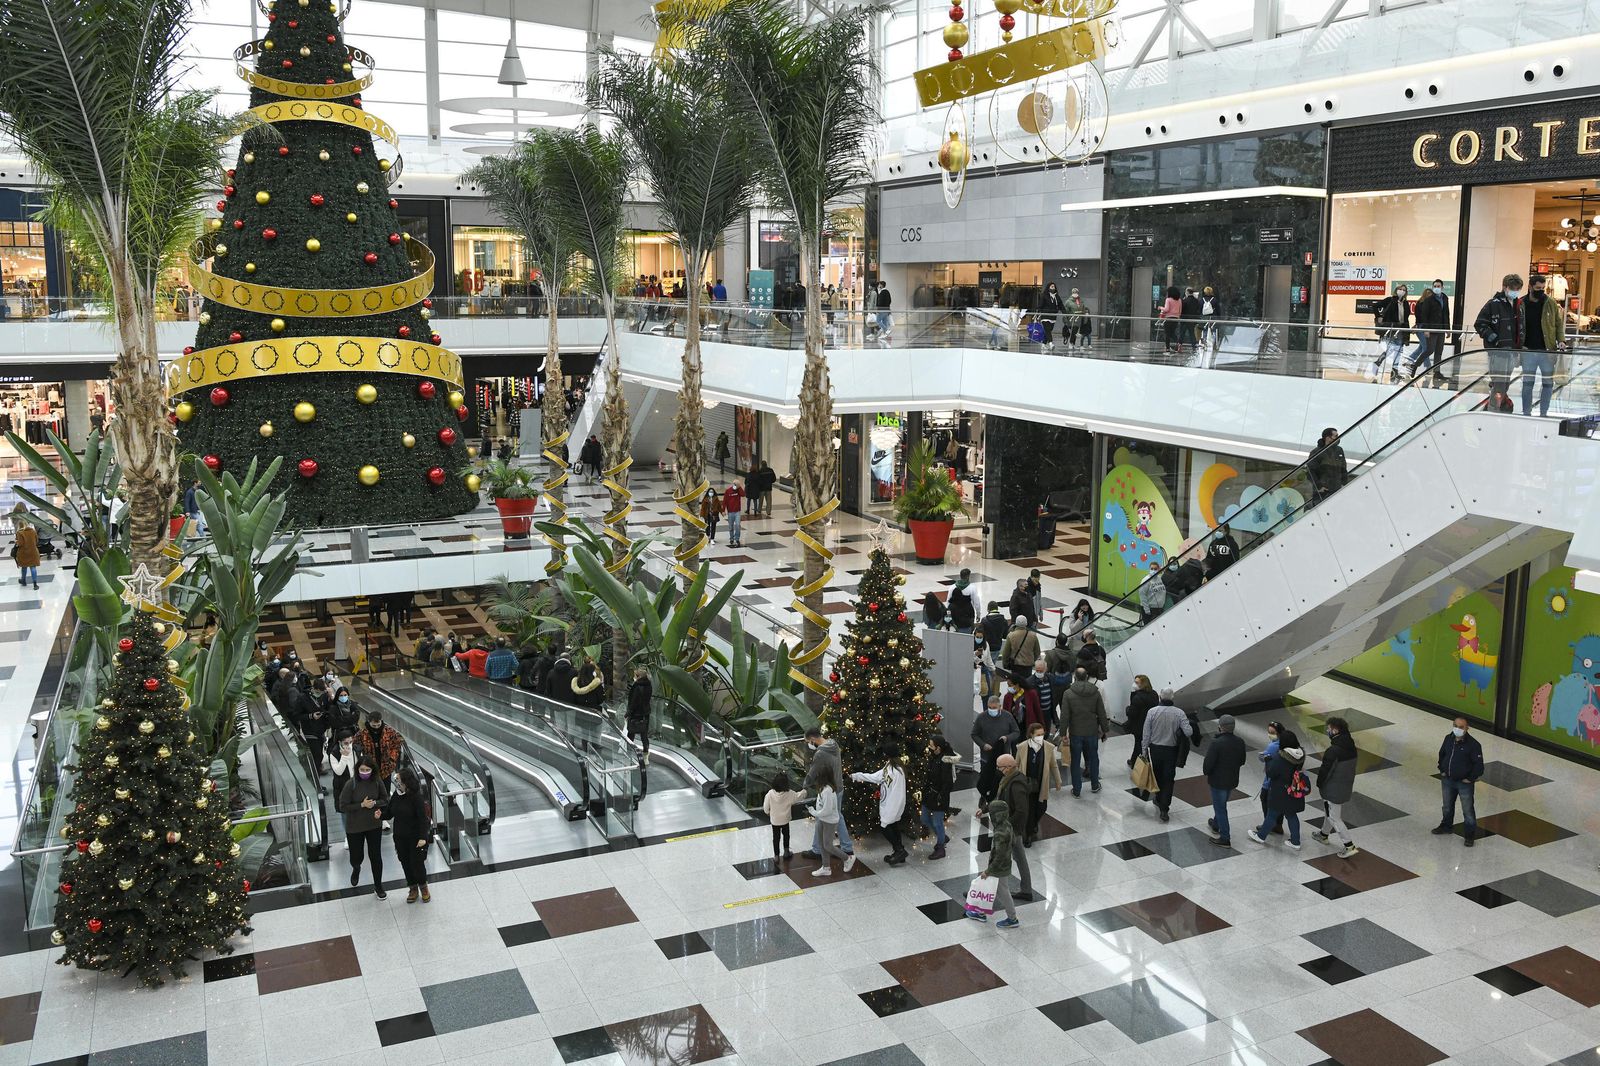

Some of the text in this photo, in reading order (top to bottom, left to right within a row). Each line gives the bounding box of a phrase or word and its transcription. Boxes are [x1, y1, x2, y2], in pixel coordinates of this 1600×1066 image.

[1412, 116, 1600, 168] CORTE
[900, 227, 922, 243] COS
[1060, 267, 1078, 278] COS
[970, 889, 996, 903] GAME
